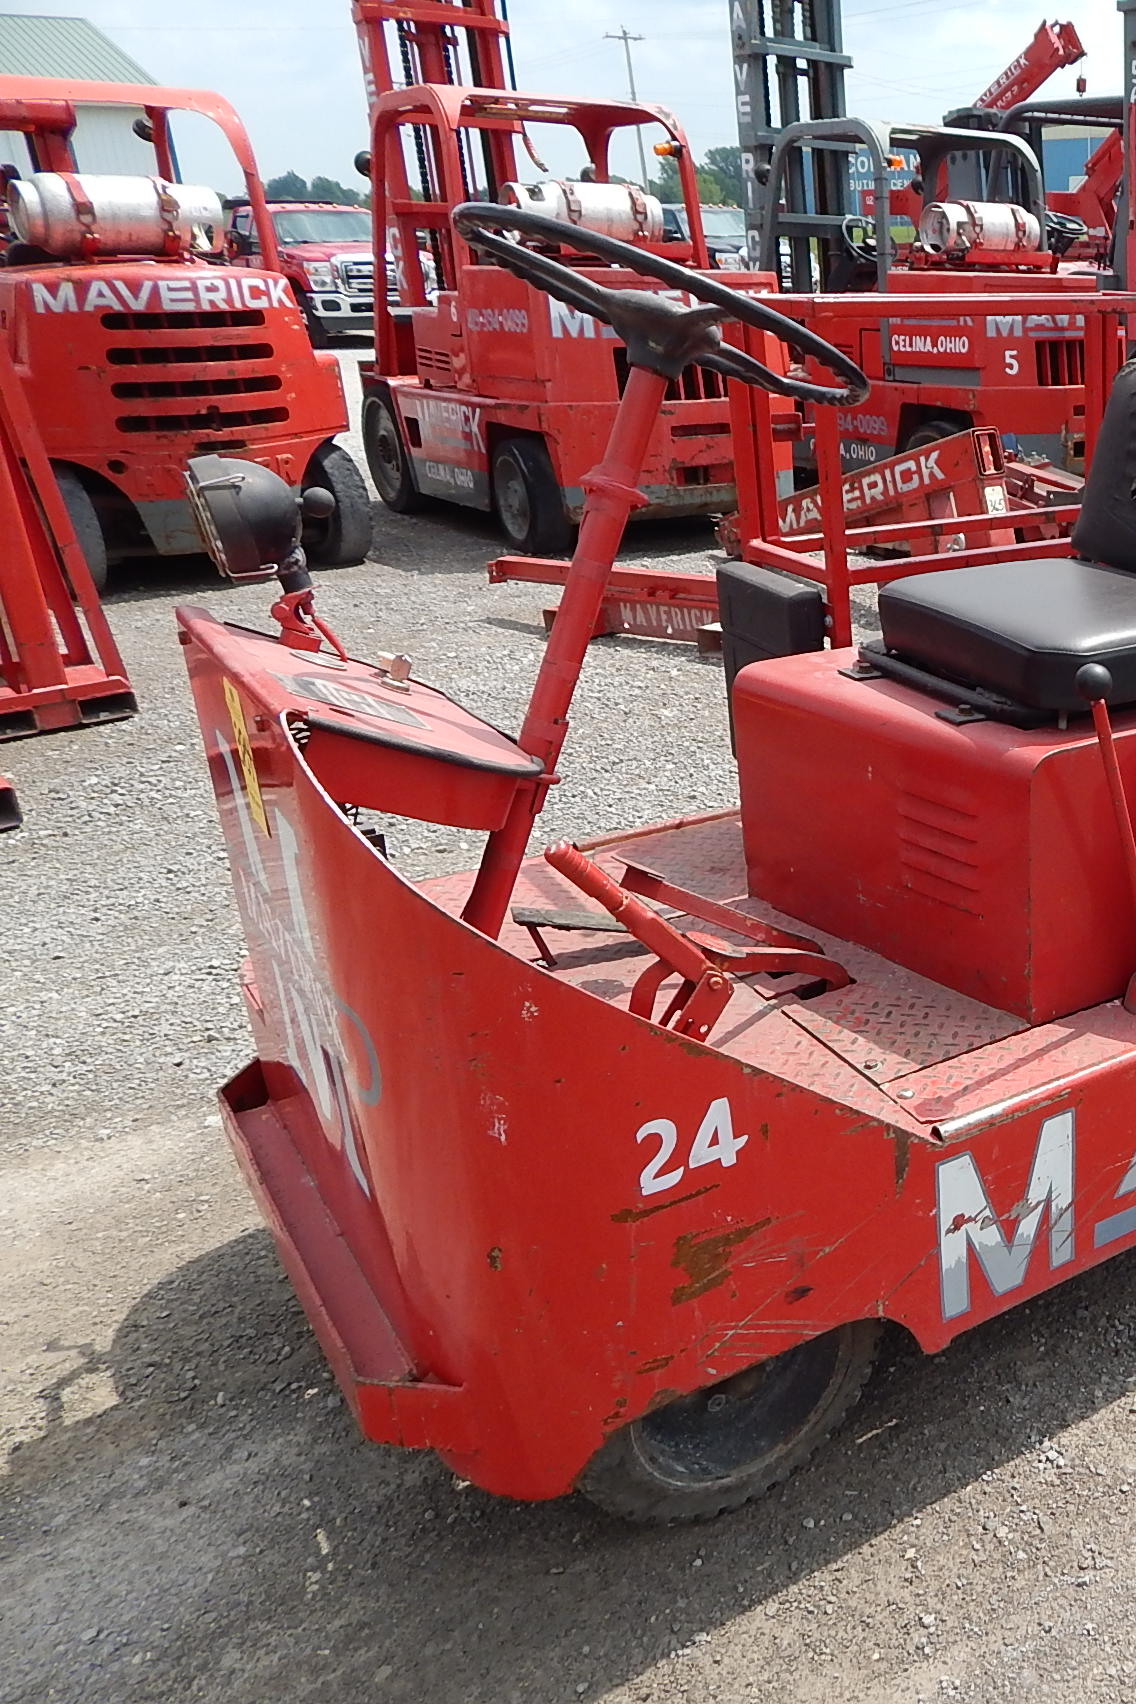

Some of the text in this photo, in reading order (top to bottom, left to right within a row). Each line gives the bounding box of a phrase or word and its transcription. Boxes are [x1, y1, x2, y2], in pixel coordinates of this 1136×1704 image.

[31, 277, 294, 314] MAVERICK
[450, 301, 458, 322] 6
[1004, 350, 1019, 376] 5
[777, 449, 946, 534] MAERICK
[635, 1096, 749, 1196] 24
